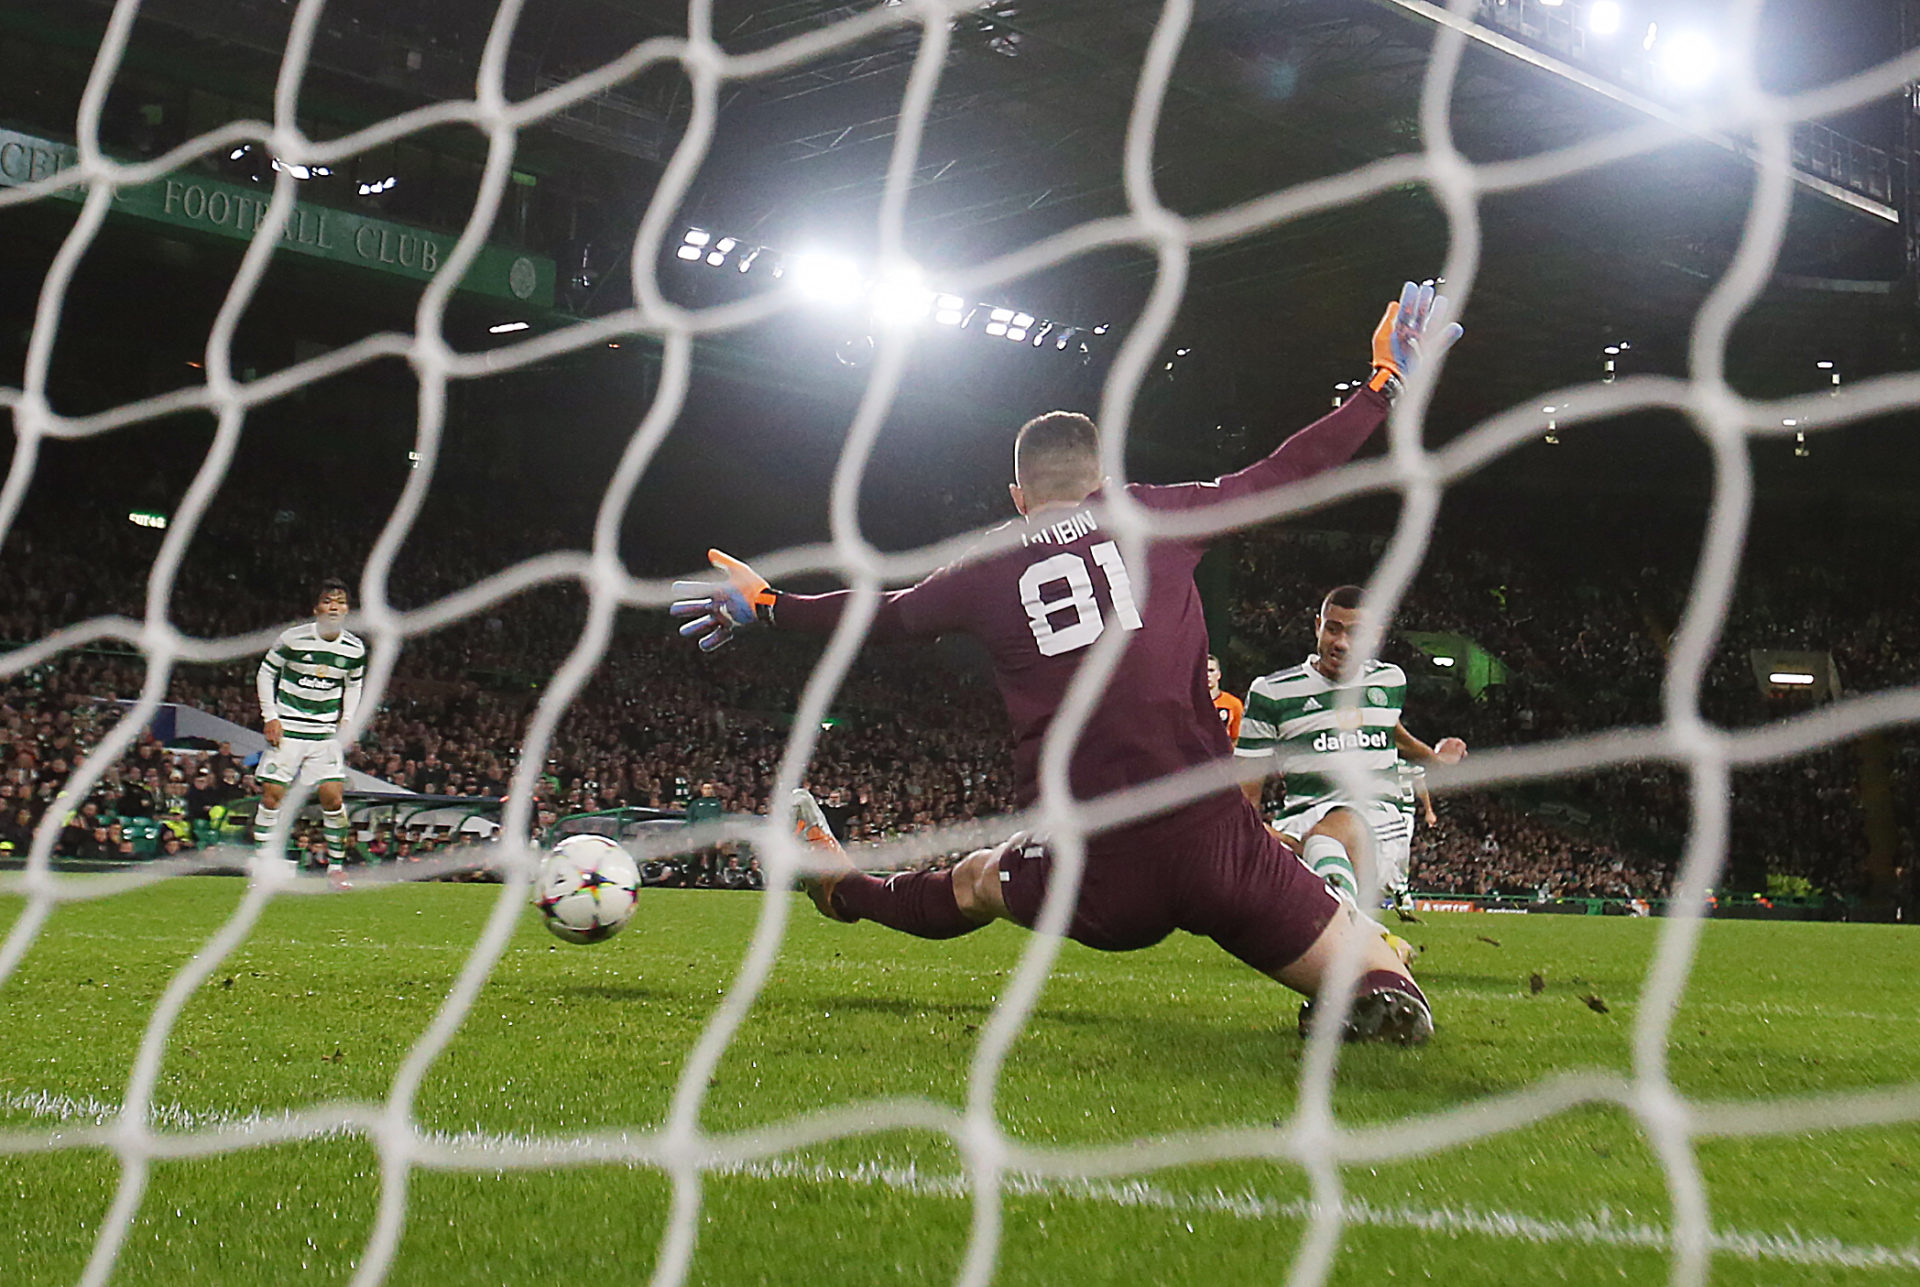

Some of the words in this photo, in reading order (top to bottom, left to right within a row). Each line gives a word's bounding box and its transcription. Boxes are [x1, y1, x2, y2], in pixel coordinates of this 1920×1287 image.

[355, 223, 438, 272] CLUB
[1018, 540, 1144, 657] 81
[1313, 729, 1388, 752] dafabet
